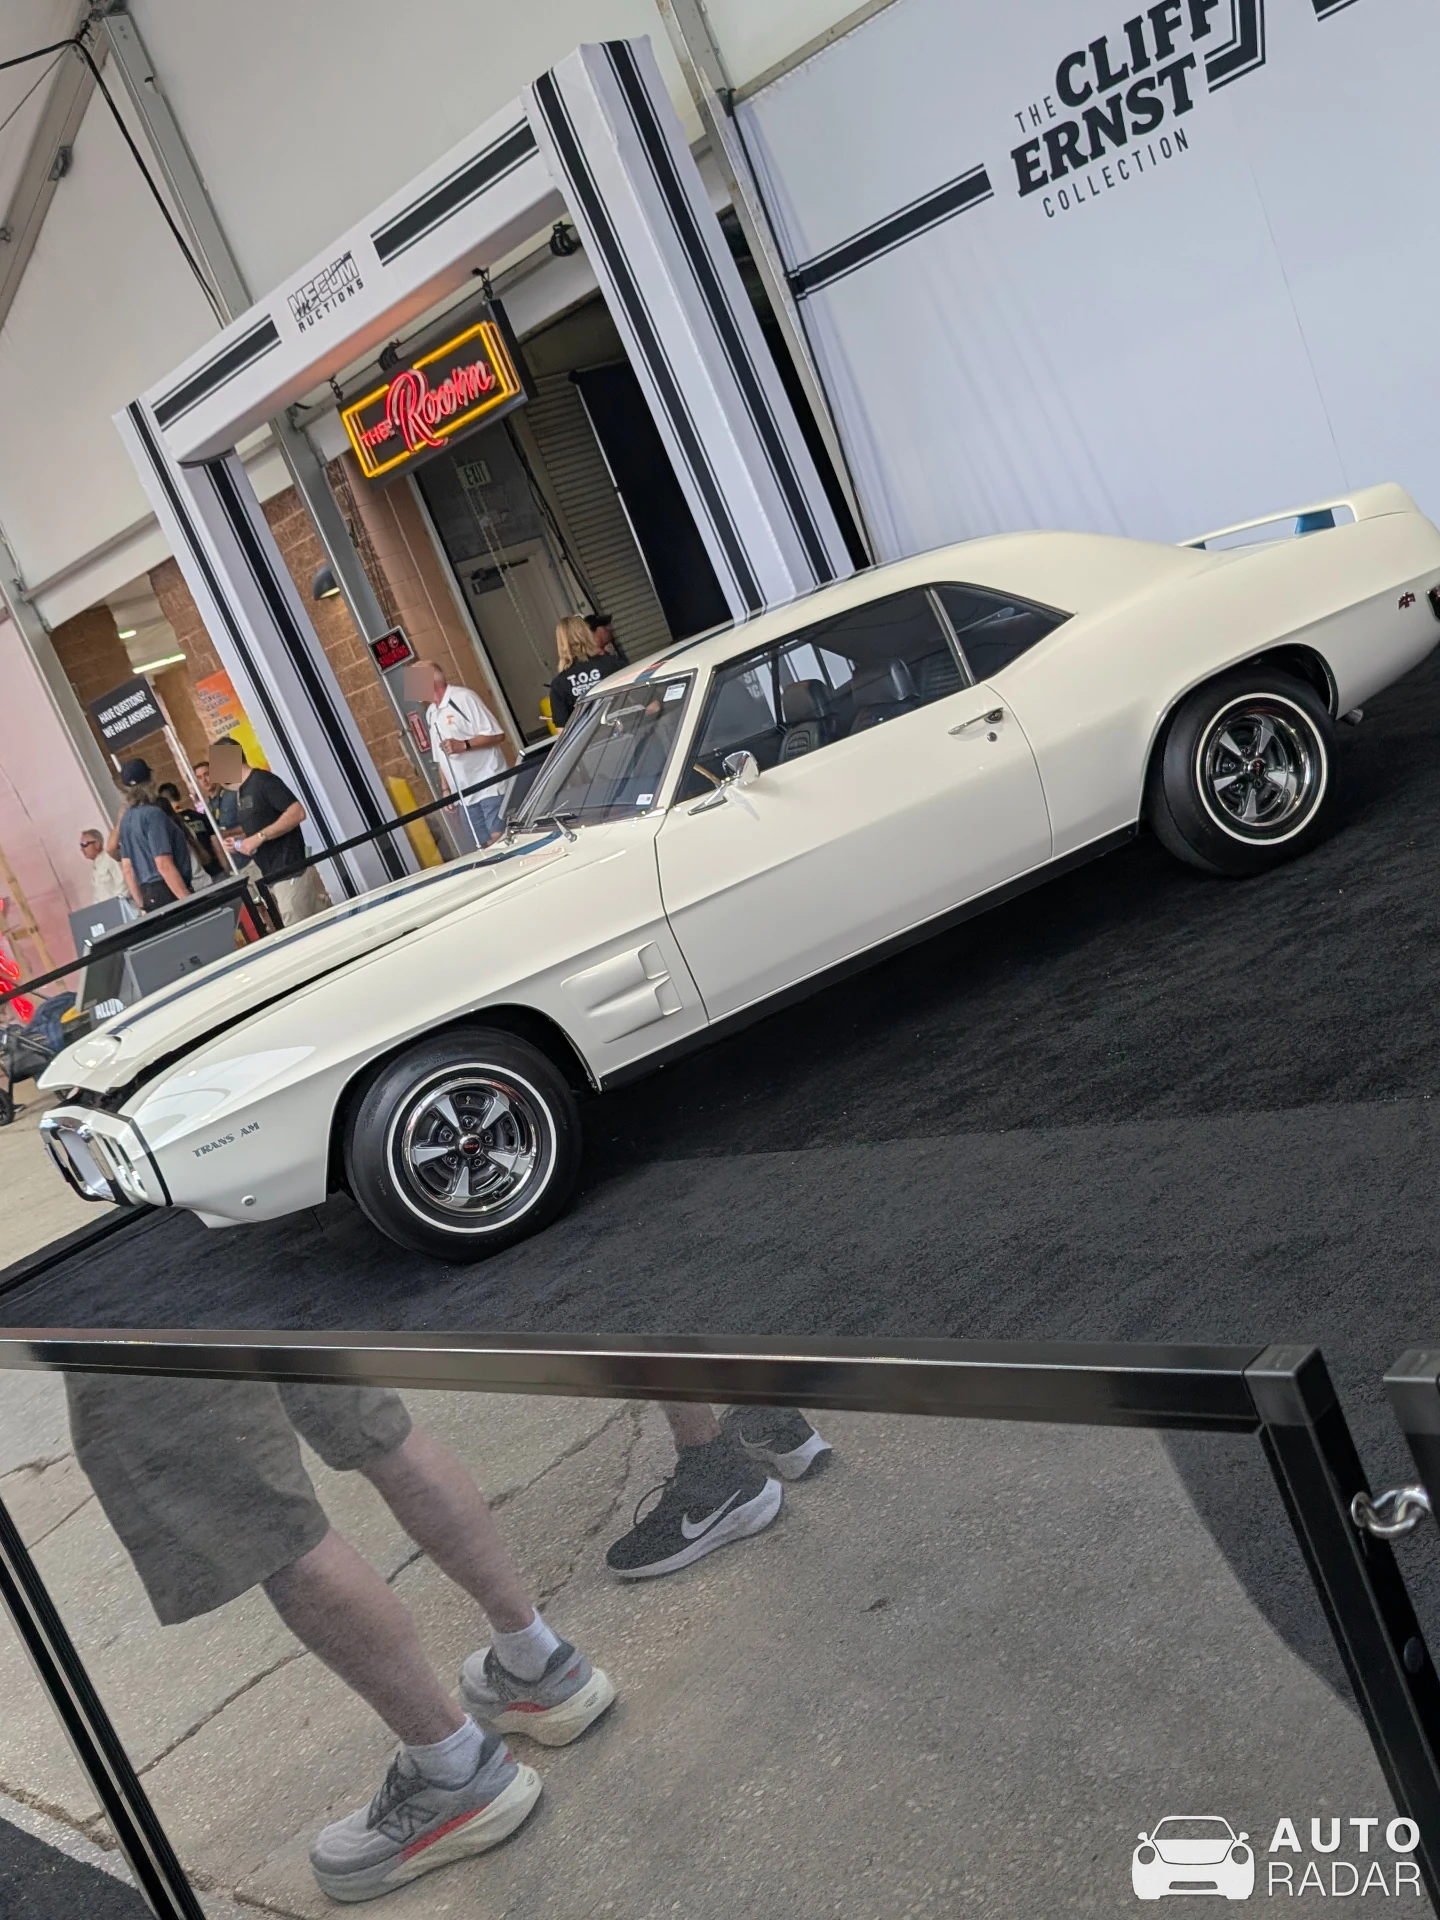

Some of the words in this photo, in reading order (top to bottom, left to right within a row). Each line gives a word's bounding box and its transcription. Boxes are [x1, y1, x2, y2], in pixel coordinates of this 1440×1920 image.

[1014, 95, 1057, 134] THE
[1055, 0, 1220, 108] CLIFF
[1010, 51, 1198, 198] ERNST
[1042, 127, 1190, 218] COLLECTION
[286, 250, 360, 323] MECUM
[297, 277, 364, 334] AUCTIONS
[360, 419, 395, 449] THE
[385, 368, 496, 453] Room
[463, 461, 487, 486] EXIT
[566, 668, 602, 687] T.O.G
[98, 707, 117, 725] HAVE
[112, 689, 148, 717] QUESTIONS?
[101, 724, 117, 739] WE
[111, 717, 132, 734] HAVE
[191, 1132, 236, 1158] TRANS
[239, 1121, 261, 1138] AM
